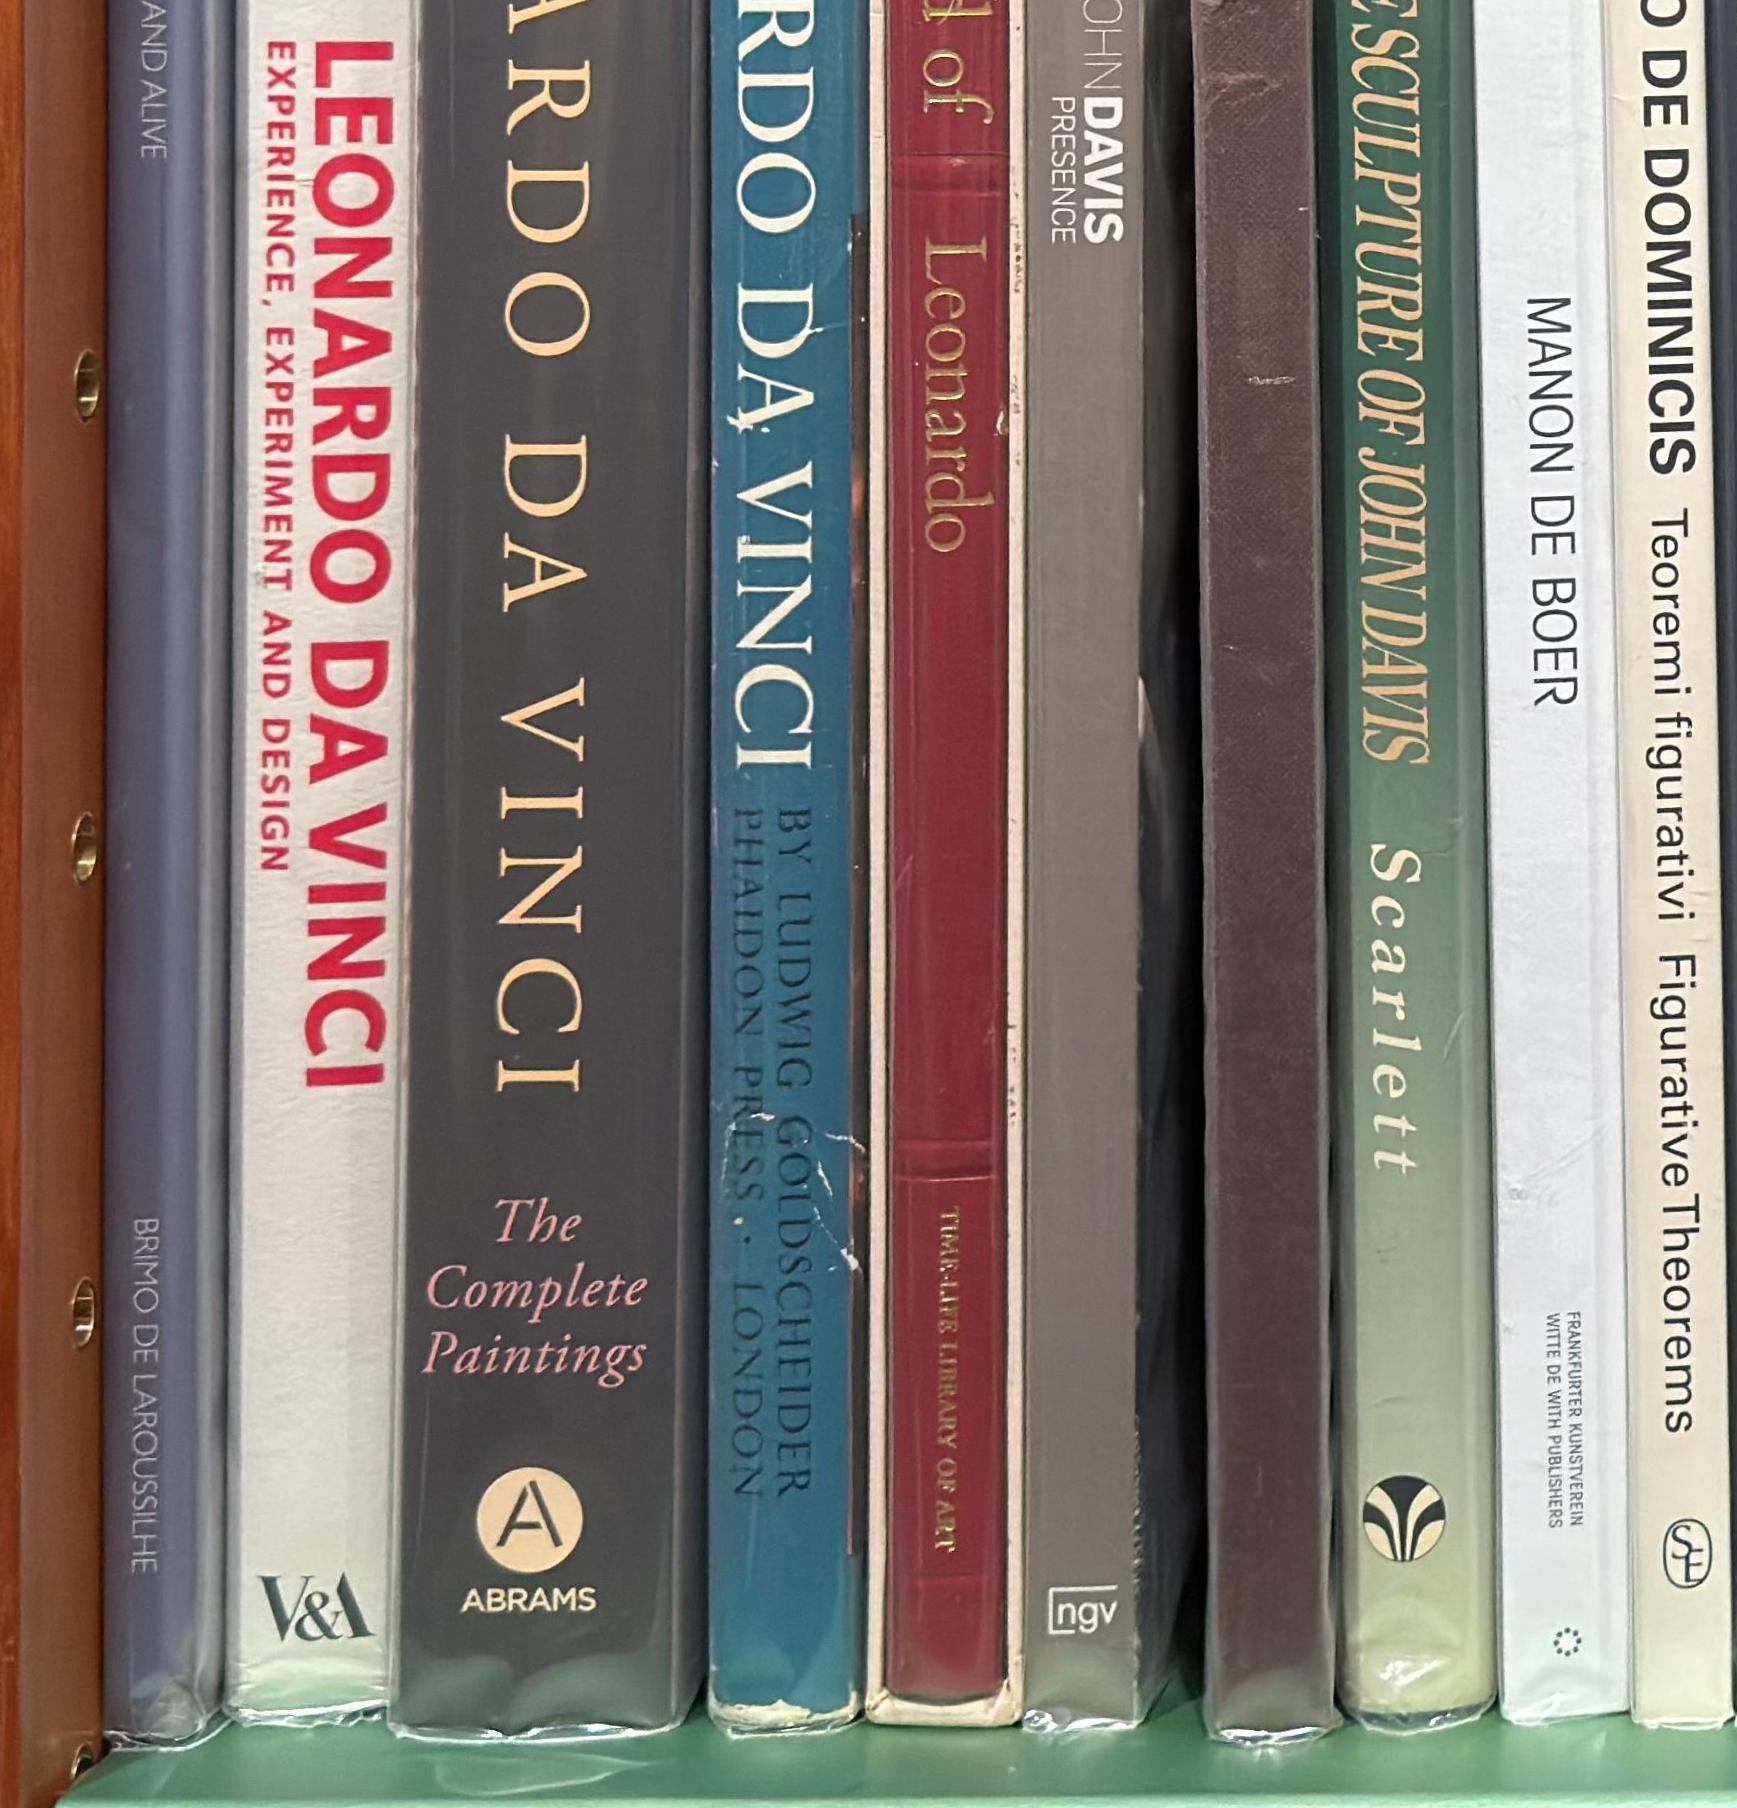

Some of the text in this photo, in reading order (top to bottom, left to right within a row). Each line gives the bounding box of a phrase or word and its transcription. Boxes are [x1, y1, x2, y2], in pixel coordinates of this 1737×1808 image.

[140, 0, 168, 72] AND
[140, 80, 168, 159] ALIVE
[920, 48, 997, 123] of
[1640, 45, 1689, 124] DE
[1052, 96, 1076, 243] PRESENCE
[1350, 23, 1423, 357] SCULPTURE
[733, 283, 816, 434] DA
[918, 236, 995, 553] Leonardo
[1644, 145, 1697, 473] DOMINICIS
[260, 40, 297, 871] EXPERIENCE, EXPERIMENT AND DESIGN
[1355, 367, 1427, 445] OF
[307, 39, 394, 1088] LEONARDO DA VINCI
[504, 435, 588, 612] DA
[1354, 449, 1428, 594] JOHN
[1526, 294, 1579, 705] MANON DE BOER
[735, 462, 815, 771] VINCI
[1358, 599, 1430, 765] DAVIS
[1646, 505, 1697, 919] Teoremi figurativi
[497, 677, 586, 1092] VINCI
[1369, 842, 1421, 1175] Scarlett
[495, 1196, 584, 1244] The
[1650, 950, 1705, 1431] Figurative Theorems
[422, 1330, 648, 1389] Paintings
[426, 1261, 649, 1324] Complete
[934, 1205, 962, 1551] TIME-LIFE LIBRARY OF ART
[130, 1217, 160, 1573] BRIMO DE LAROUSSILHE
[1565, 1311, 1584, 1526] FRANKFURTER KUNSTVEREIN
[256, 1571, 376, 1642] V&A
[460, 1587, 598, 1613] ABRAMS
[1057, 1601, 1118, 1634] ngv
